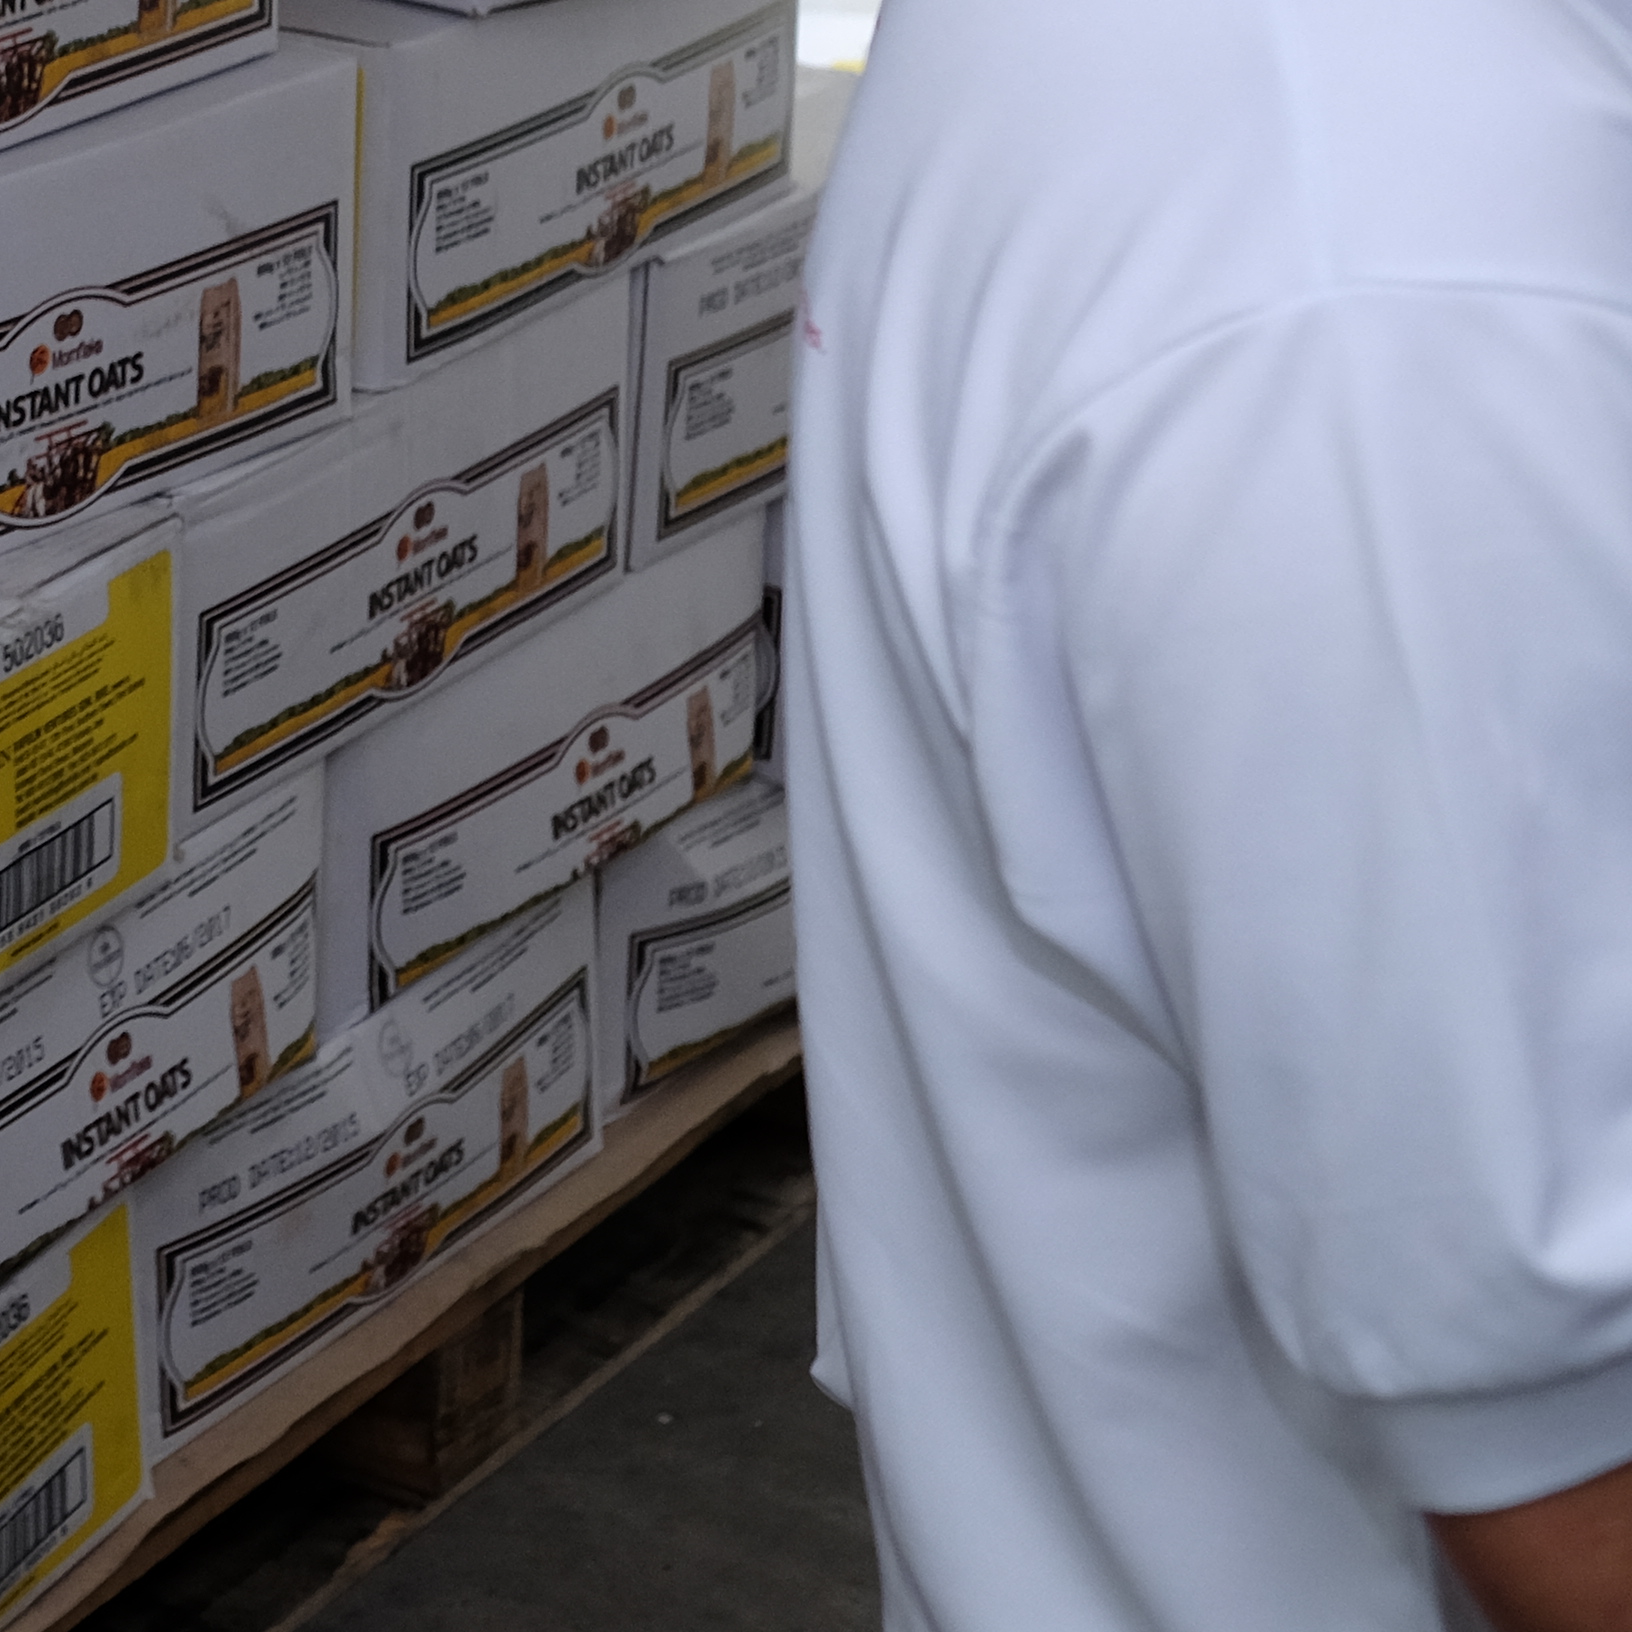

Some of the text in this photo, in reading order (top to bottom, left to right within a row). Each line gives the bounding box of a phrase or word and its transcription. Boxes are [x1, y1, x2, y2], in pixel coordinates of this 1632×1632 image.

[575, 123, 675, 195] INSTANT OATS
[87, 351, 145, 399] OATS
[368, 532, 479, 621] INSTANT OATS
[2, 613, 65, 673] 502036
[551, 756, 657, 841] INSTANT OATS
[60, 1057, 192, 1171] INSTANT OATS
[349, 1137, 466, 1238] INSTANT OATS
